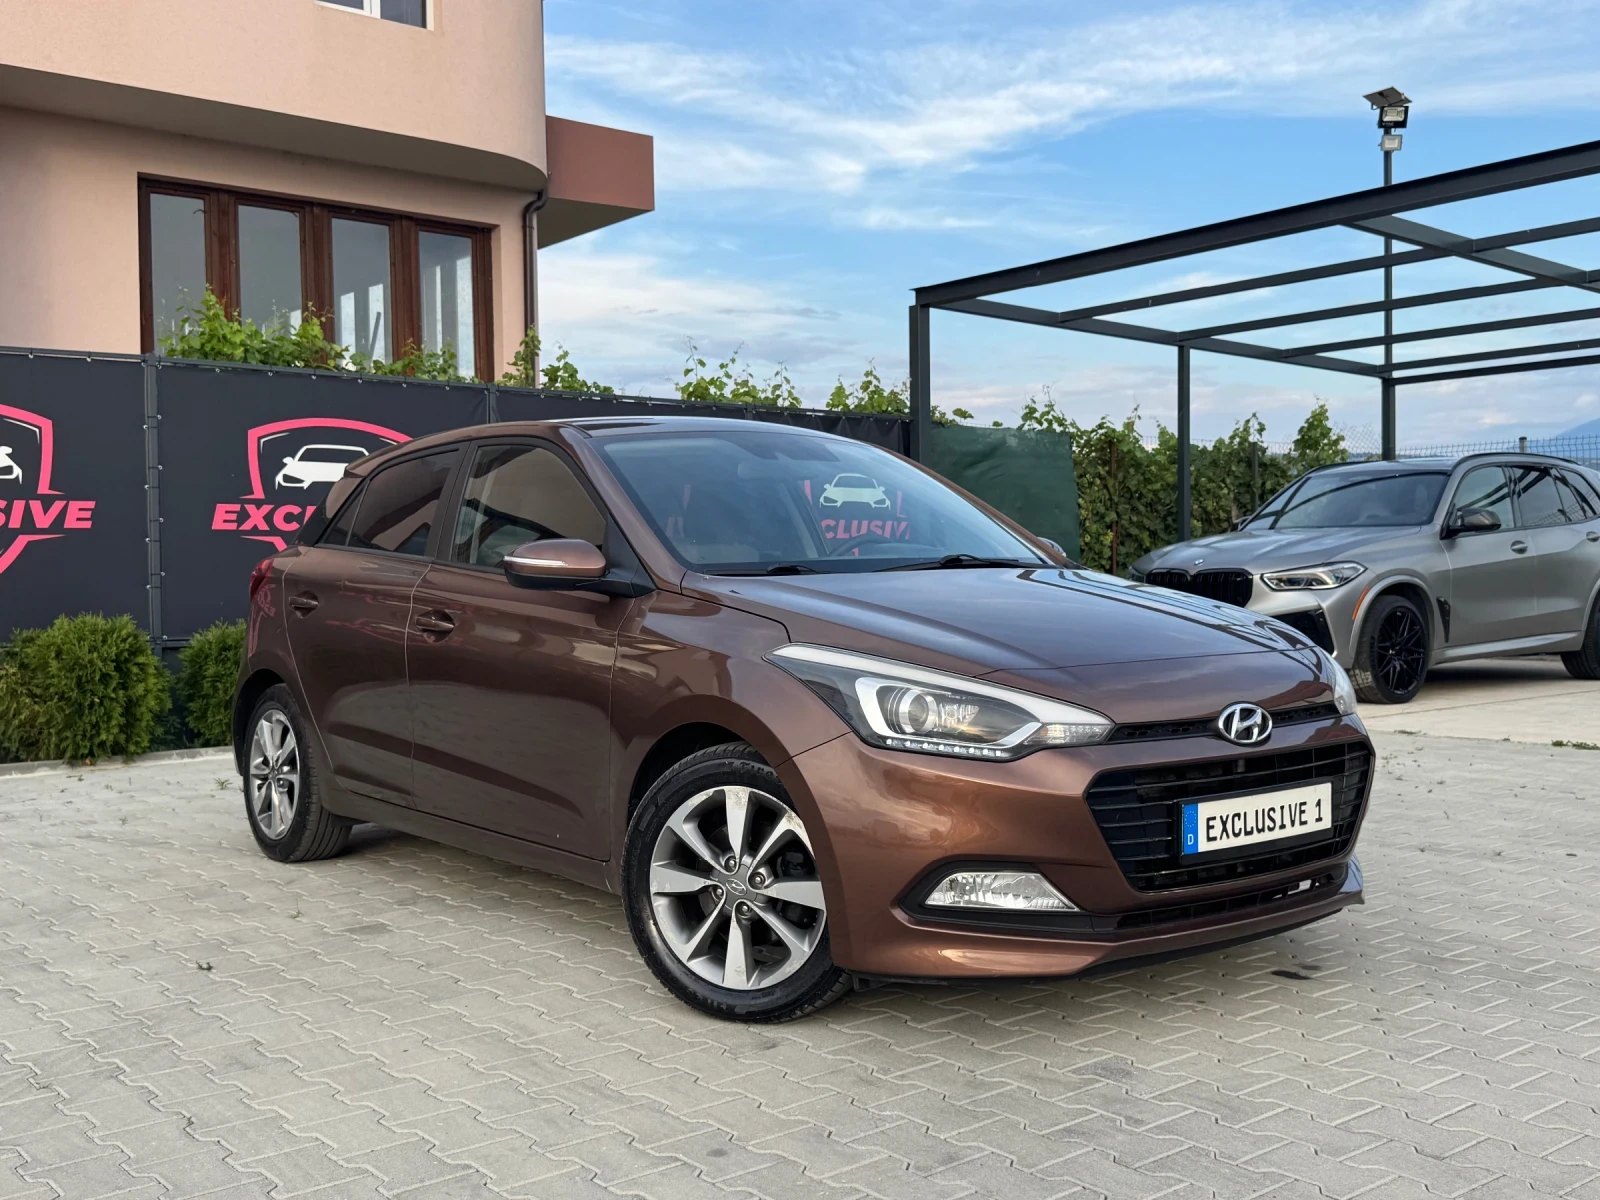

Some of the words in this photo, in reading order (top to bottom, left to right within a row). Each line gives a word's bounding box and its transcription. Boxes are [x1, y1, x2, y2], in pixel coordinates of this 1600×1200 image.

[0, 500, 96, 528] IVE
[820, 519, 910, 540] CLUSIV
[1206, 801, 1308, 842] EXCLUSIVE
[1314, 798, 1324, 823] 1
[1187, 833, 1195, 846] D
